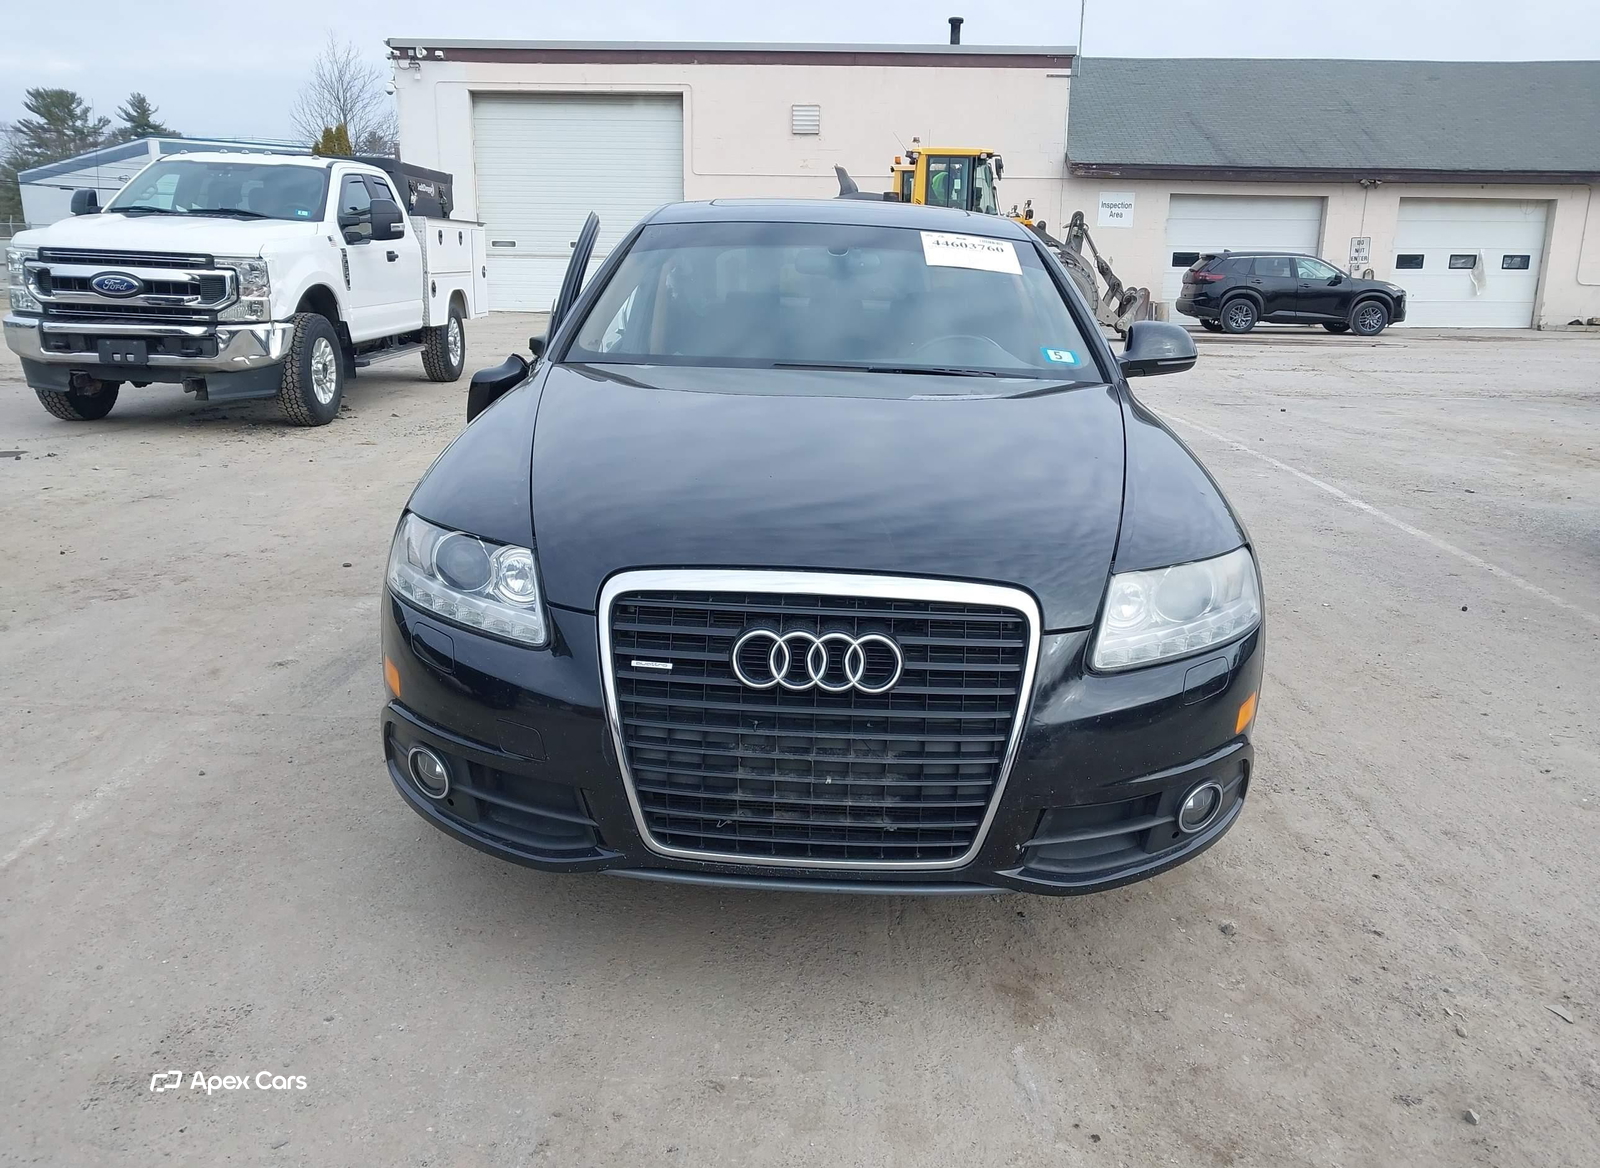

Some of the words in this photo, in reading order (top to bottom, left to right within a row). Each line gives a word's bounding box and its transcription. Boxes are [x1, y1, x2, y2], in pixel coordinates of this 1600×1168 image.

[1101, 201, 1132, 210] Inspection
[1109, 210, 1123, 218] Area
[932, 239, 1004, 253] 44603760
[102, 279, 127, 290] Ford
[1053, 351, 1063, 360] 5
